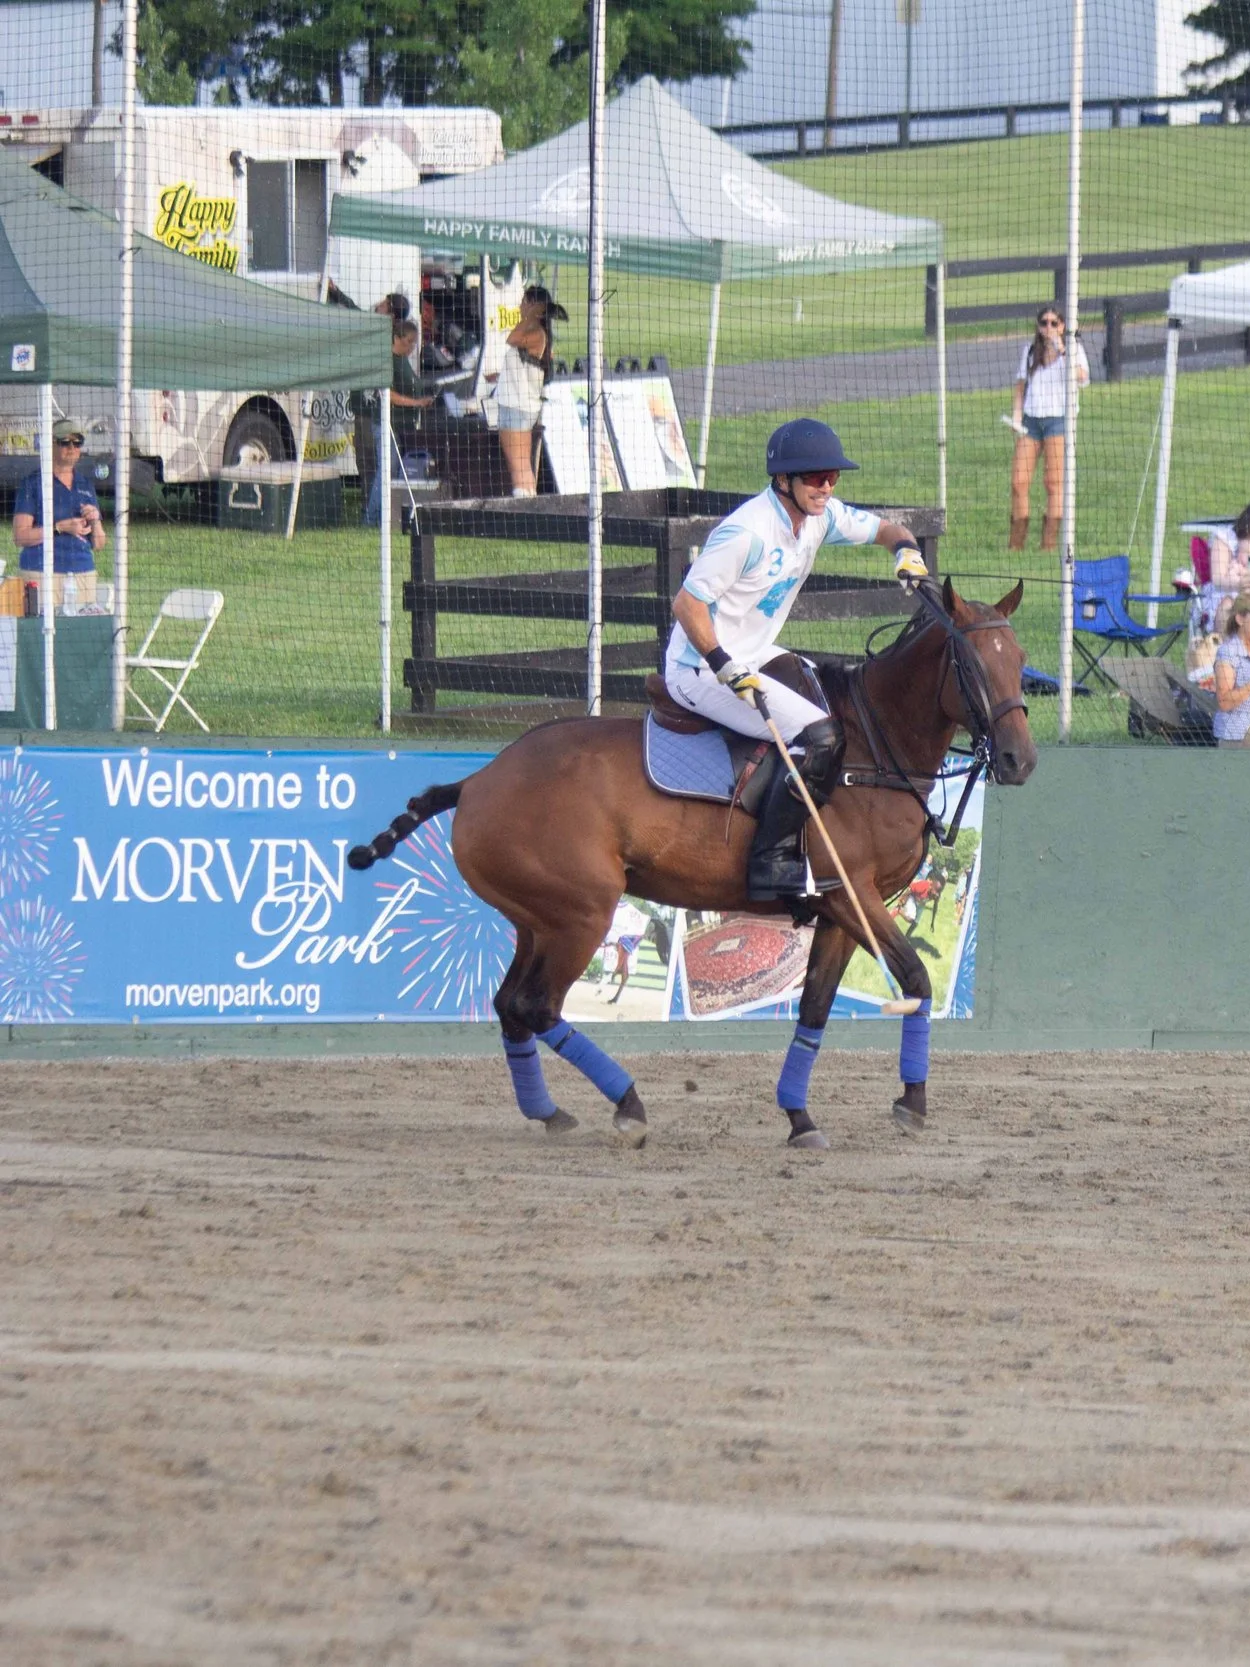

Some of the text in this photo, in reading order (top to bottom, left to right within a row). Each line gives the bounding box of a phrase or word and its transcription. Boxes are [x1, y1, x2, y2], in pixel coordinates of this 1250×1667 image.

[156, 184, 236, 236] Happy
[423, 218, 485, 241] HAPPY
[488, 224, 552, 247] FAMILY
[777, 245, 815, 263] HAPPY
[767, 547, 785, 577] 3
[101, 758, 357, 810] Welcome to
[71, 836, 349, 904] MORVEN
[235, 877, 419, 970] Park
[125, 977, 321, 1014] morvenpark.org
